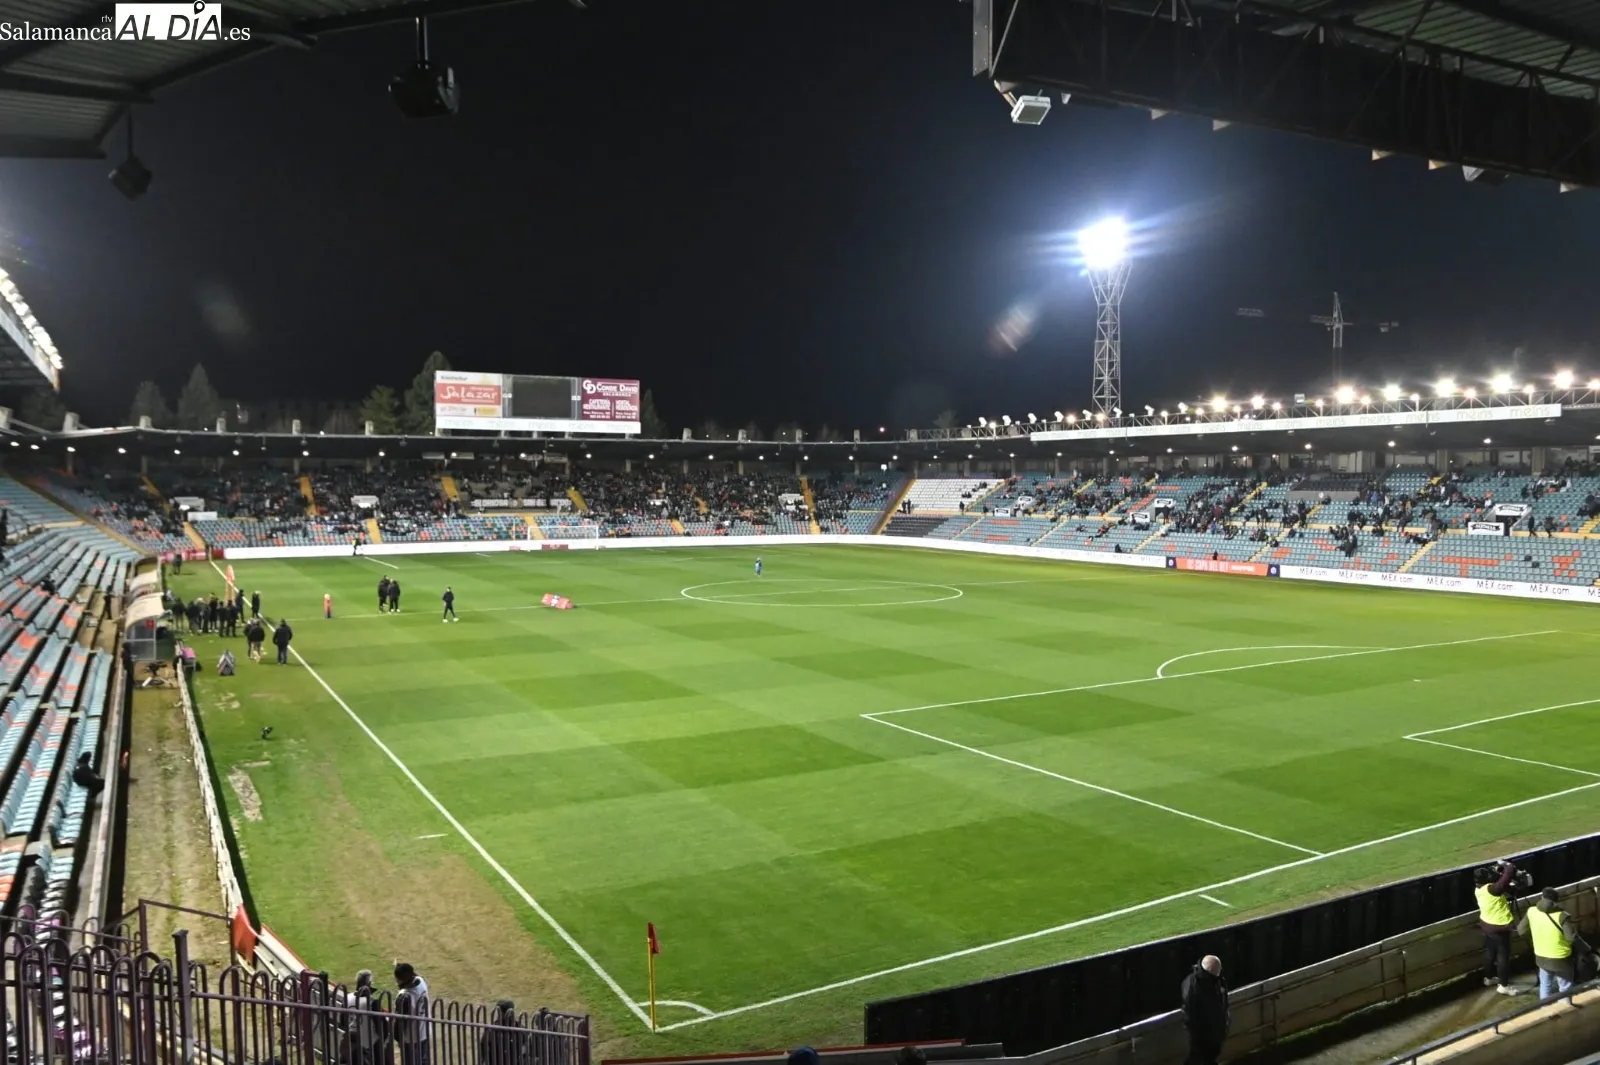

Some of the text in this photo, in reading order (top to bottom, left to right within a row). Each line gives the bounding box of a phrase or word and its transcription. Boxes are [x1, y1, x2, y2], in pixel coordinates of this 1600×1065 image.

[440, 386, 499, 400] Salazar
[1359, 415, 1391, 425] meins
[1456, 408, 1494, 420] meins
[1509, 406, 1550, 417] meins
